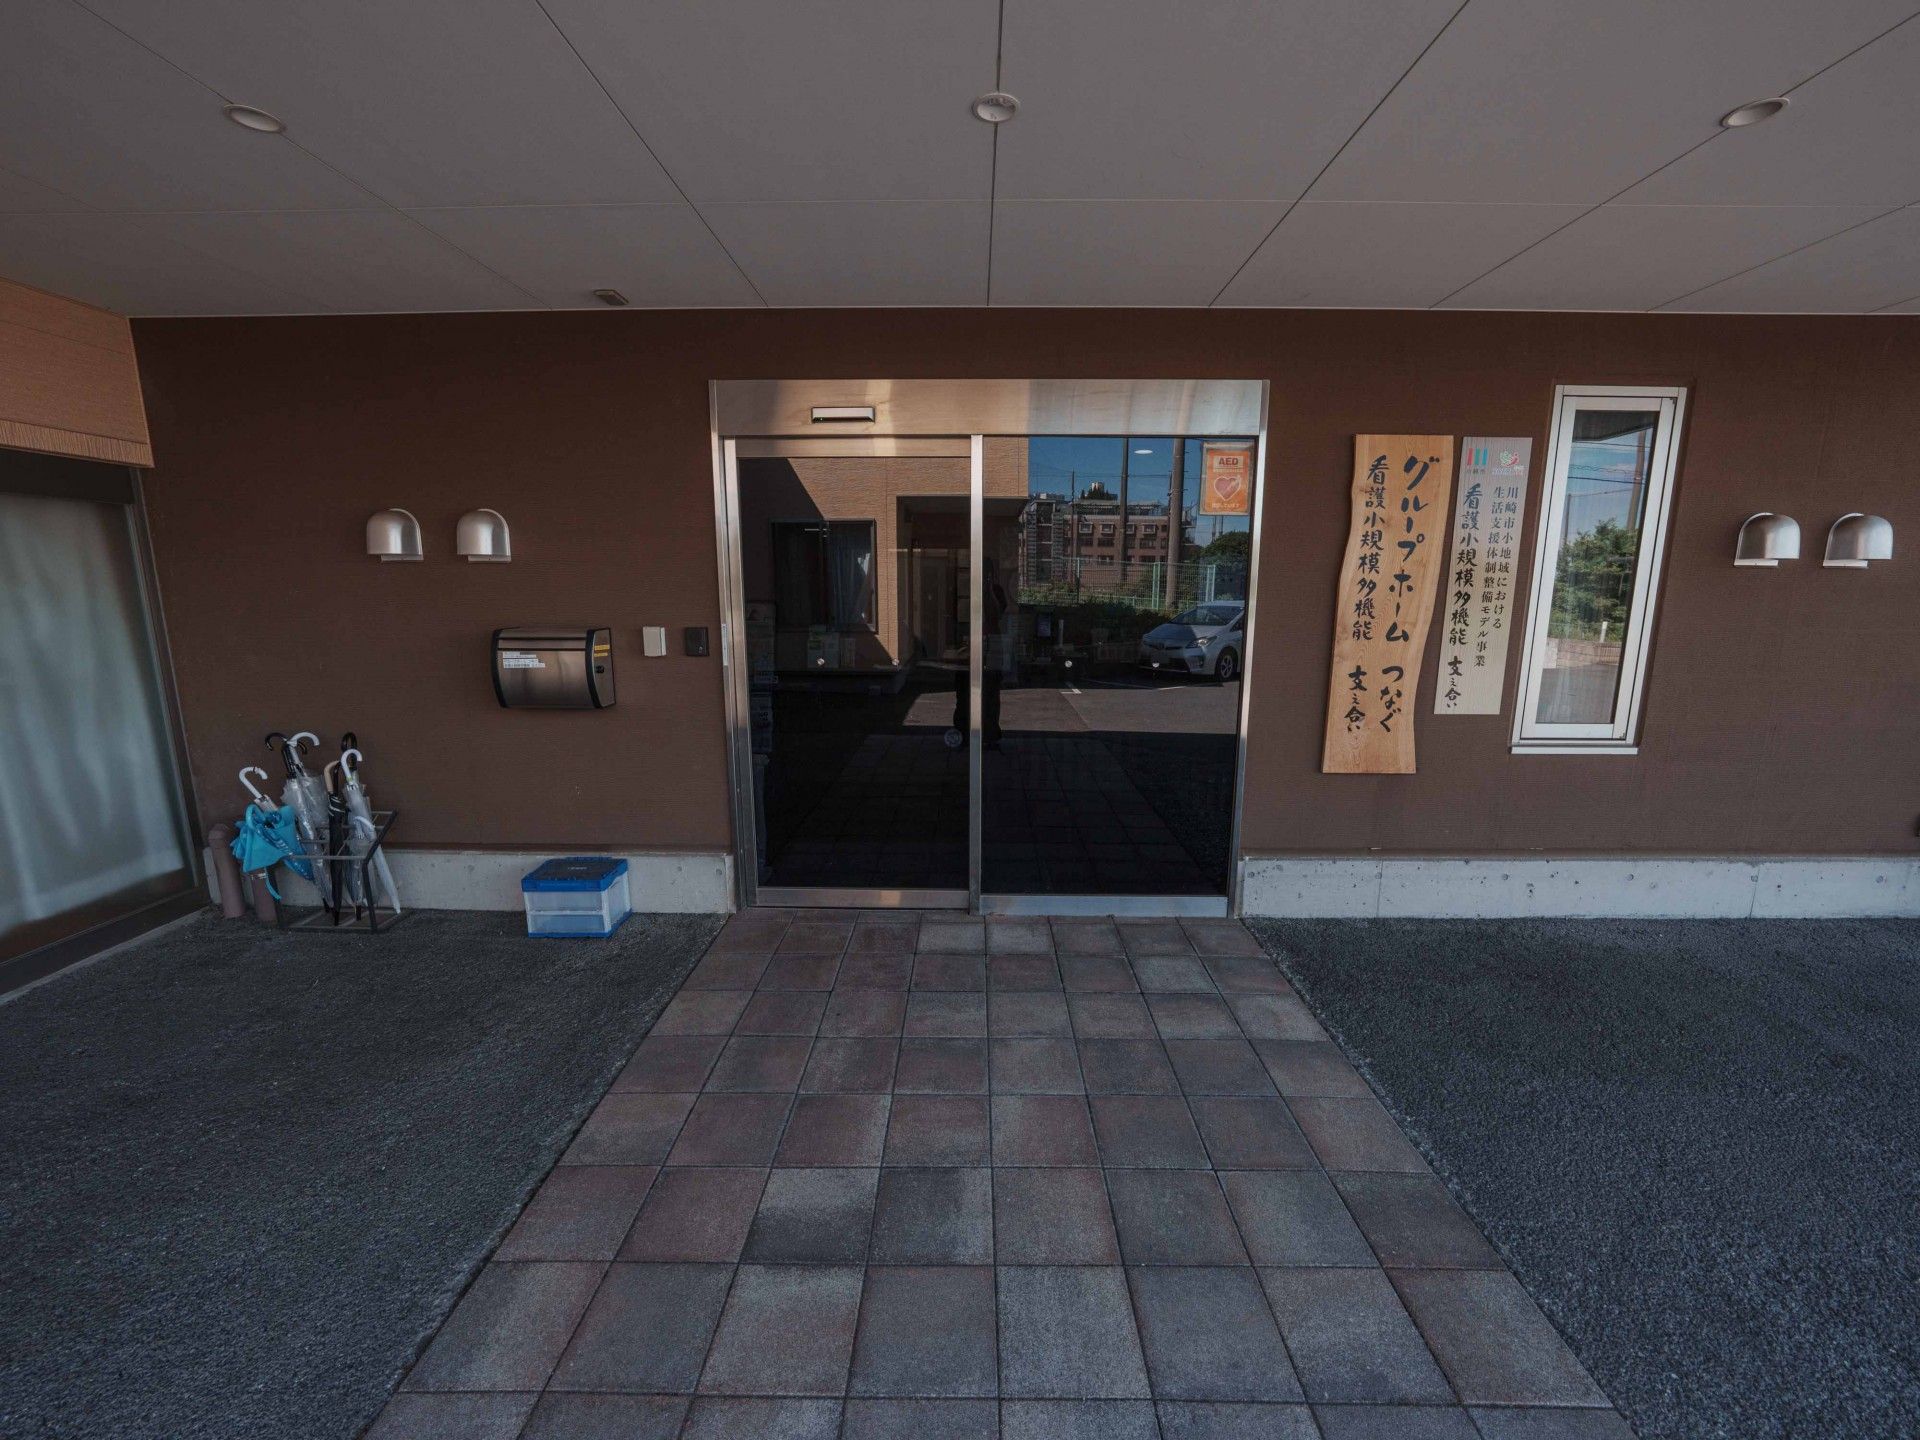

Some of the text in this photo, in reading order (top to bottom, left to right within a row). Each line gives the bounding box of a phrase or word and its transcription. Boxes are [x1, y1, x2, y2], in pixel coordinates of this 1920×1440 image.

[1218, 457, 1239, 466] AED
[1343, 454, 1391, 733] 看護小規模多機能 支え合い
[1379, 455, 1440, 733] グループホーム つなぐ
[1449, 483, 1483, 646] 看護小規模多機能
[1473, 486, 1505, 667] 生活支援体制整備モデル事業
[1492, 486, 1519, 629] 川崎市小地域における
[1444, 655, 1463, 708] 支え合い
